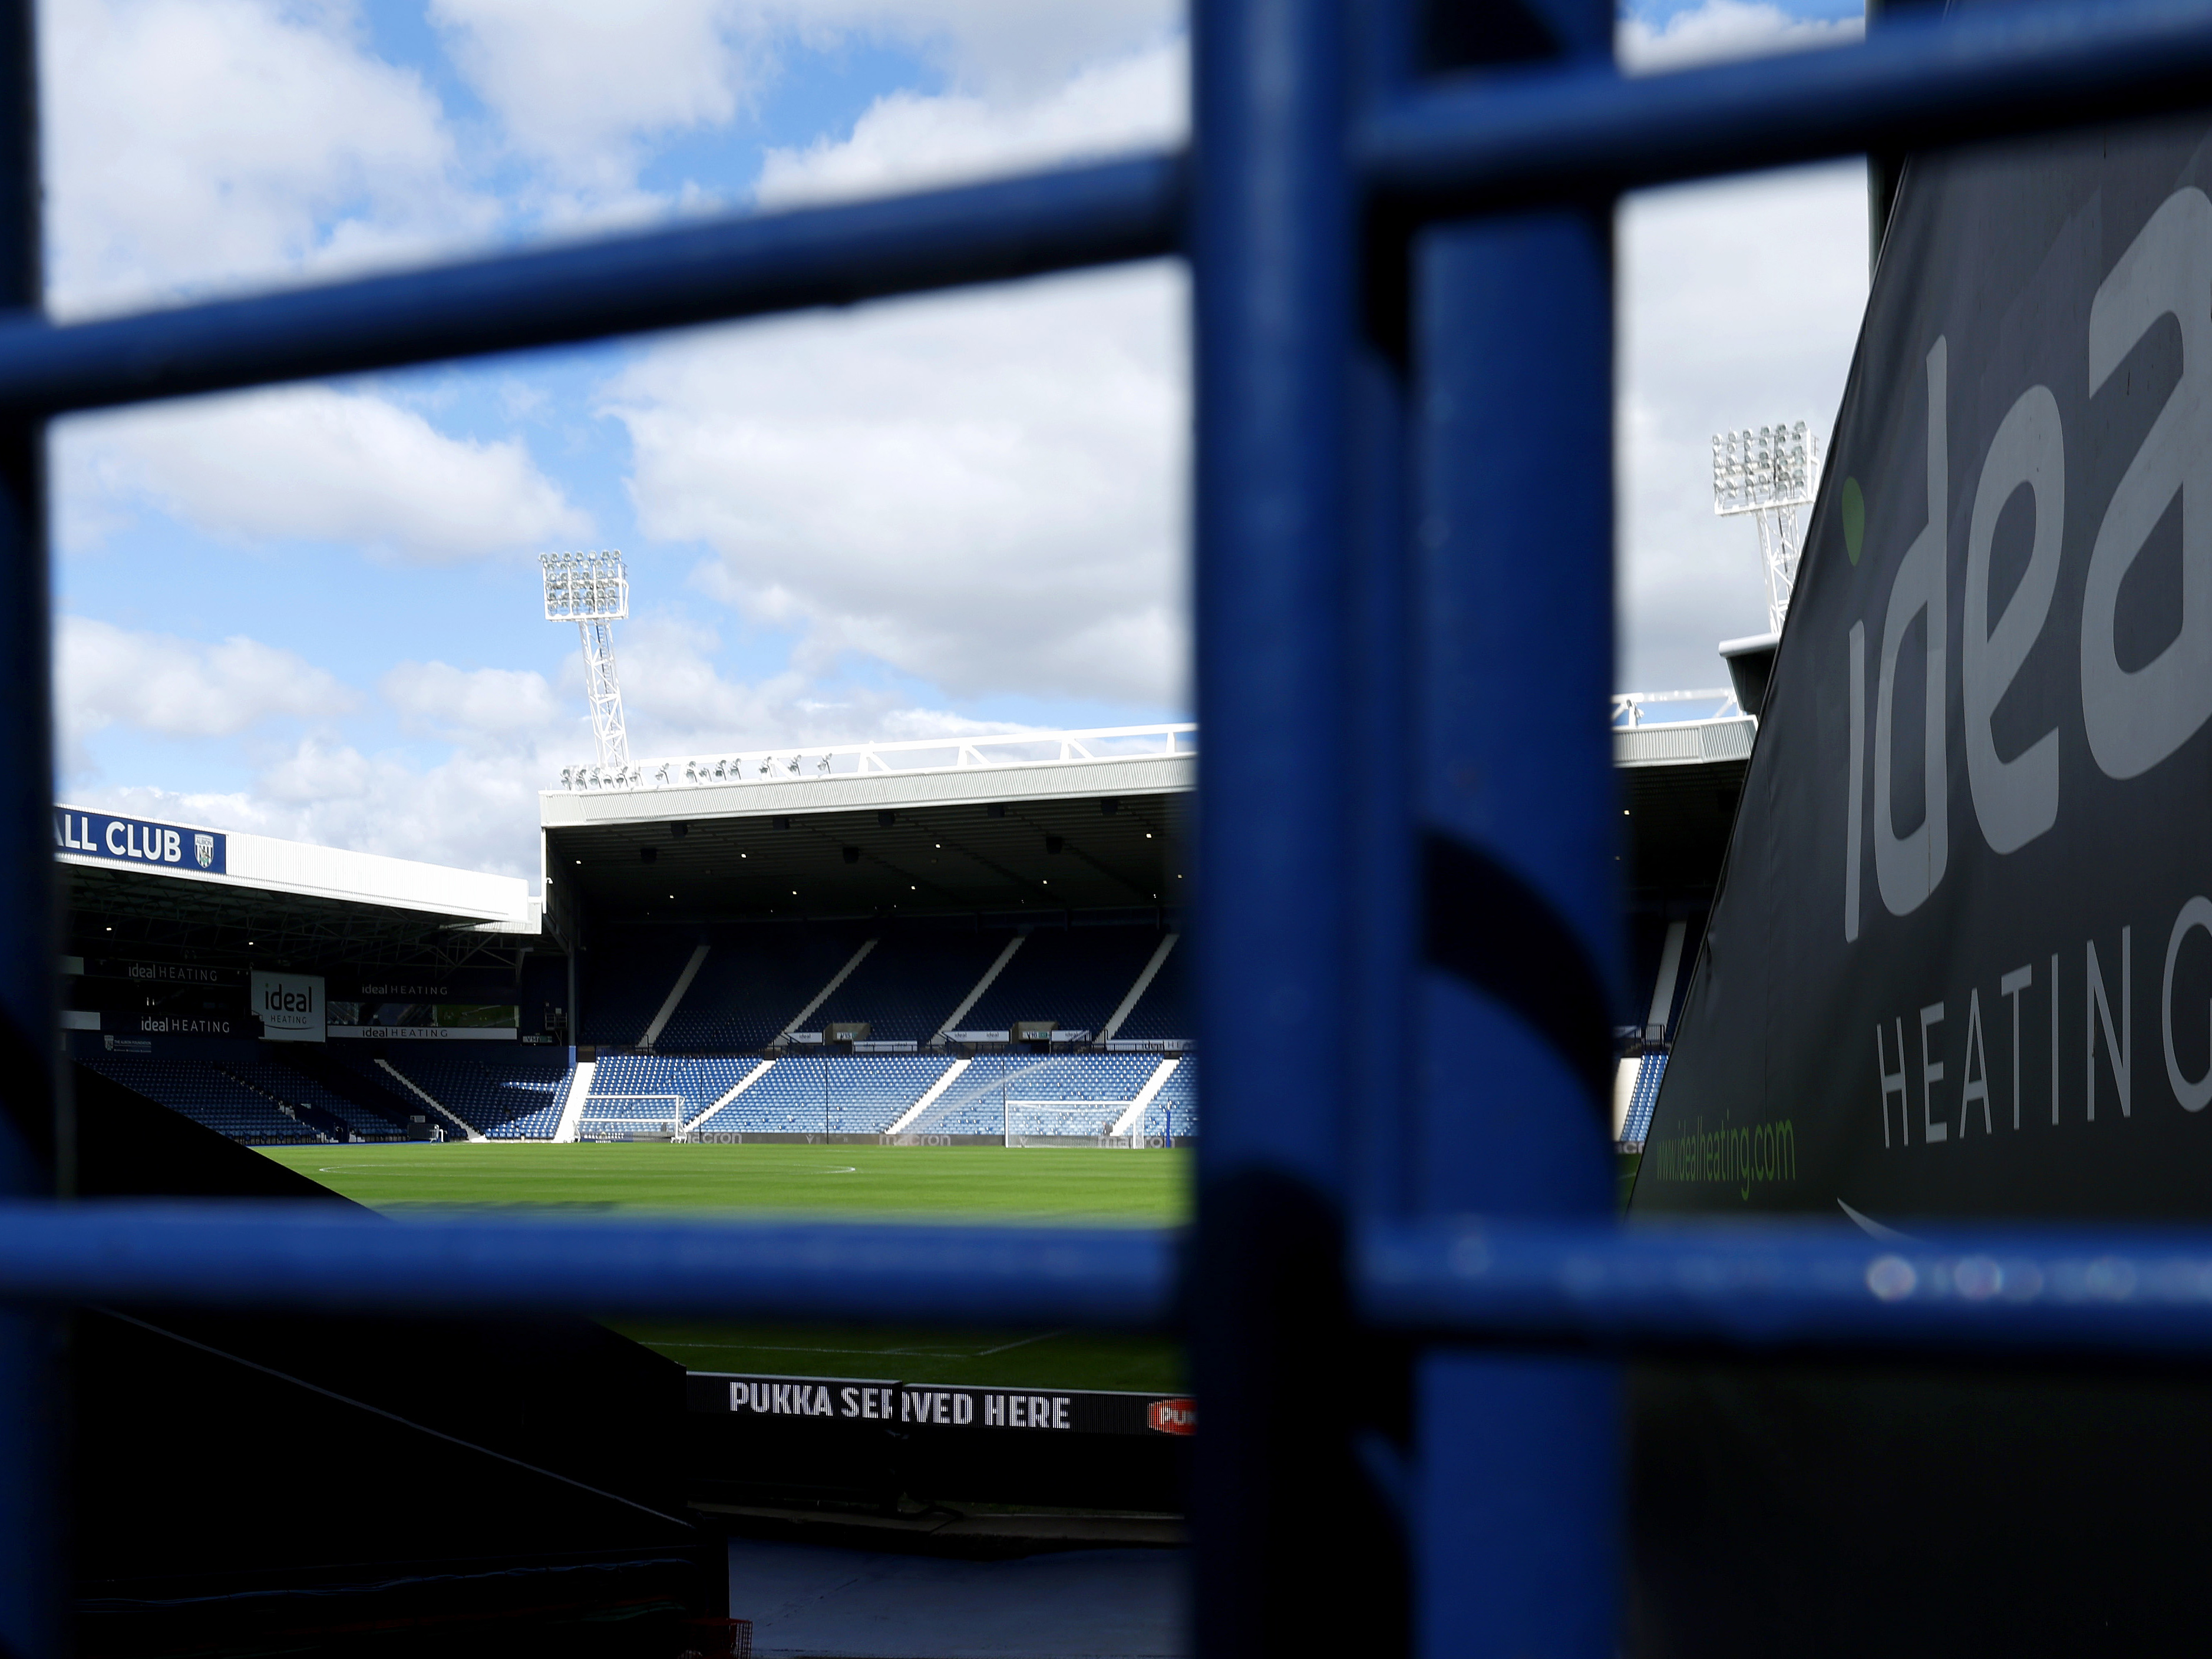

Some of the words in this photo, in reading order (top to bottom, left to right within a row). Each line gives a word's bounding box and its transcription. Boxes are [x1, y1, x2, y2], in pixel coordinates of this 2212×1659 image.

[105, 821, 181, 862] CLUB
[128, 963, 156, 979] ideal
[159, 966, 217, 981] HEATING
[265, 983, 312, 1013] ideal
[362, 984, 387, 994] ideal
[391, 985, 448, 995] HEATING
[141, 1016, 169, 1032] ideal
[172, 1019, 230, 1033] HEATING
[270, 1014, 307, 1025] HEATING
[362, 1027, 388, 1037] ideal
[391, 1029, 448, 1037] HEATING
[879, 1134, 951, 1146] macron
[1657, 1109, 1796, 1202] www.idealheating.com
[730, 1382, 833, 1416] PUKKA
[841, 1387, 972, 1425] SERVED
[985, 1394, 1071, 1429] HERE
